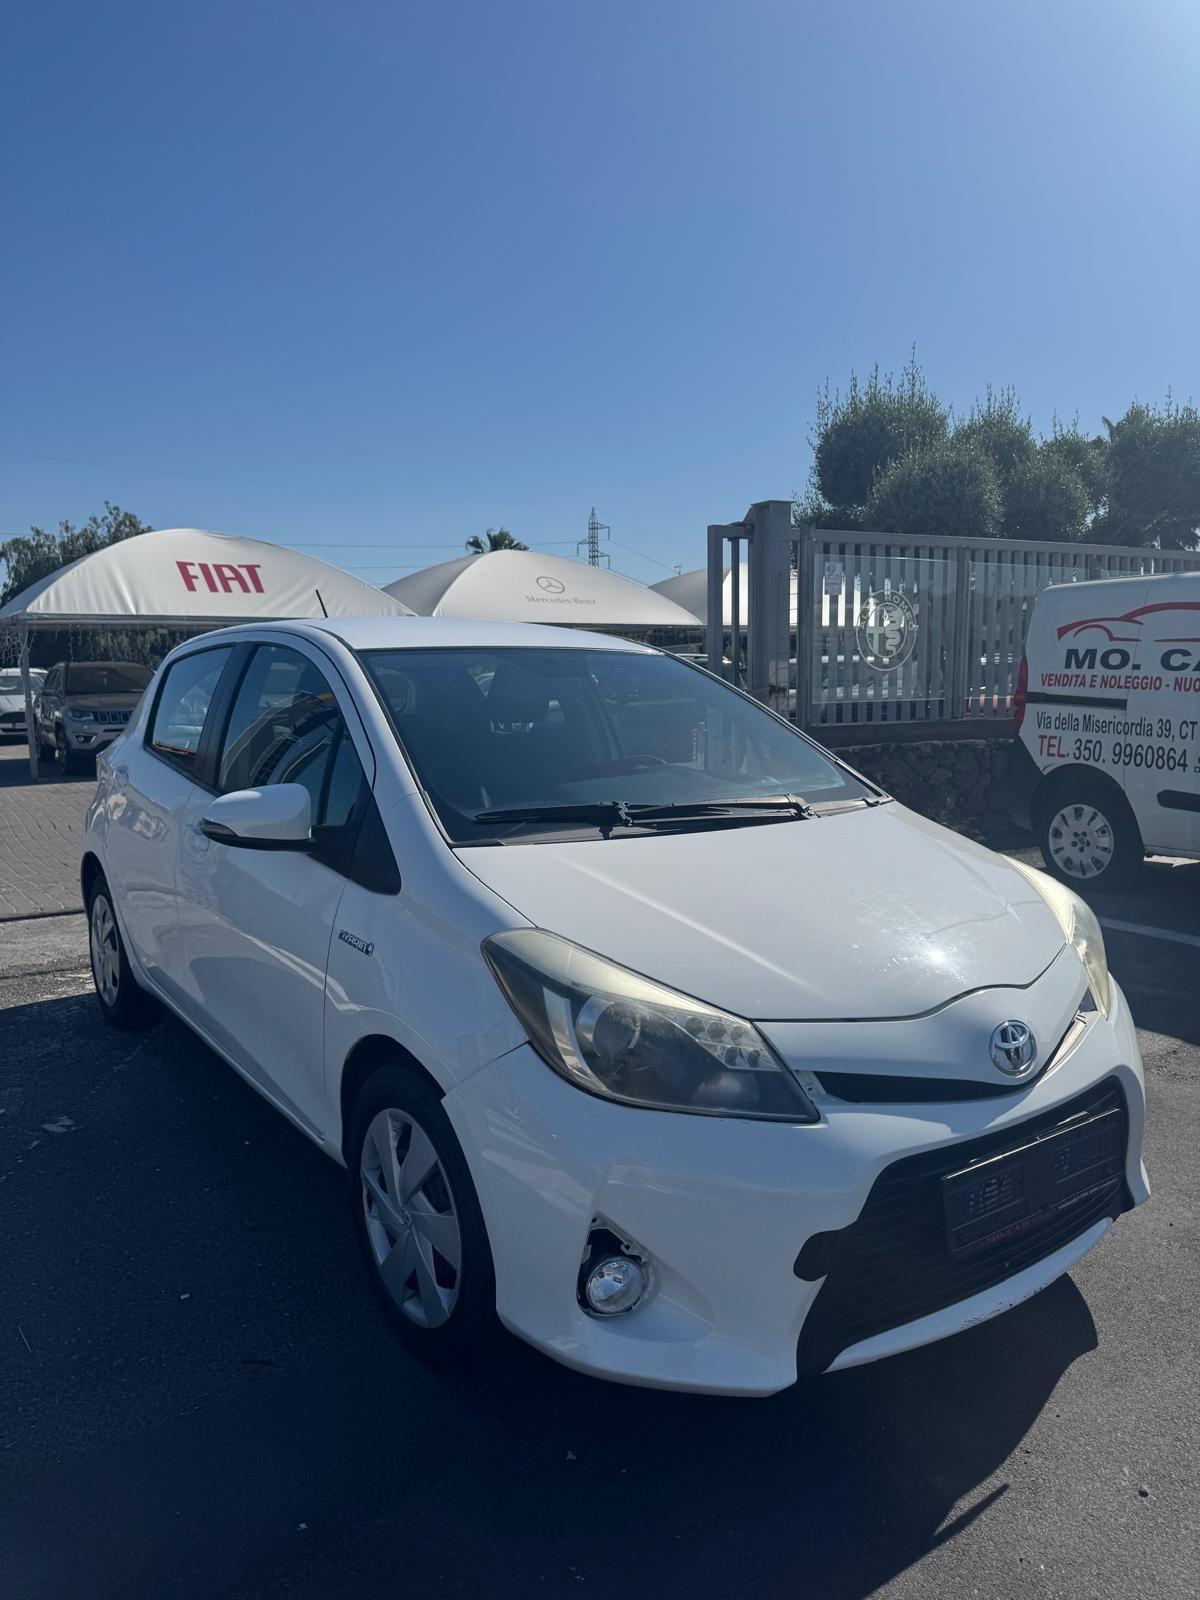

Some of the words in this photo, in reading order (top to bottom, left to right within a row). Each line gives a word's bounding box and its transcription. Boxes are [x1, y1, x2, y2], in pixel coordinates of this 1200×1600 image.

[175, 560, 265, 593] FIAT
[884, 594, 915, 631] ROMEO
[1064, 648, 1141, 671] MO.
[1041, 673, 1086, 688] VENDITA
[1089, 674, 1098, 688] E
[1100, 675, 1162, 691] NOLEGGIO
[1036, 710, 1052, 730] Via
[1054, 712, 1079, 731] della
[1082, 713, 1153, 737] Misericordia
[1156, 718, 1175, 743] 39,
[1179, 720, 1198, 741] CT
[1038, 734, 1070, 759] TEL.
[1073, 738, 1106, 764] 350.
[1111, 742, 1188, 773] 9960864
